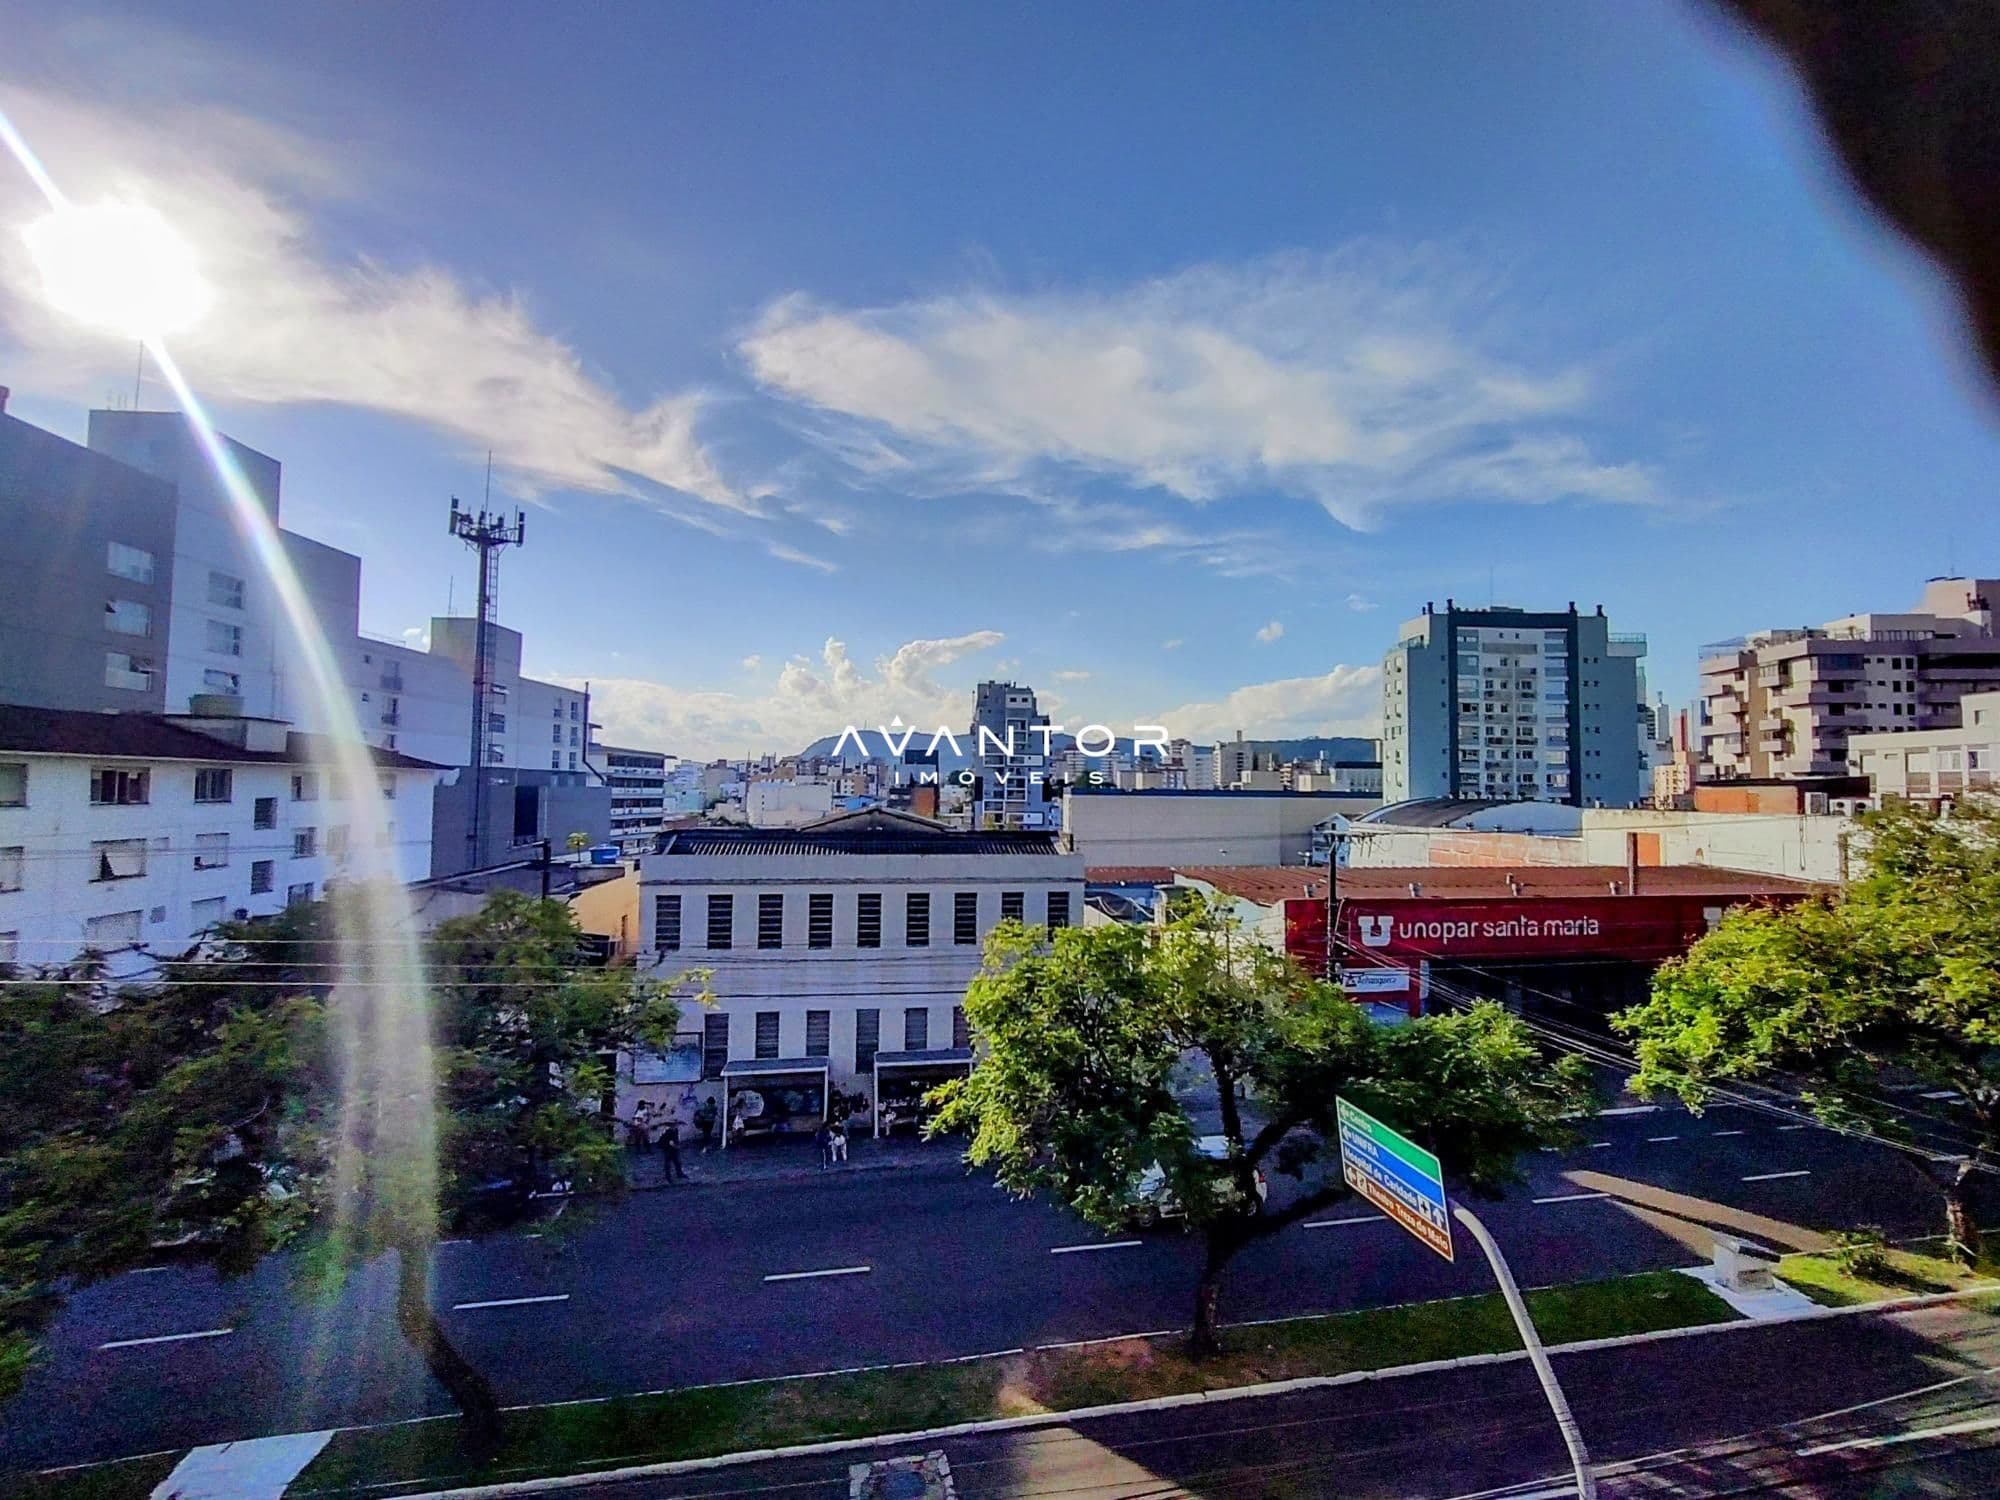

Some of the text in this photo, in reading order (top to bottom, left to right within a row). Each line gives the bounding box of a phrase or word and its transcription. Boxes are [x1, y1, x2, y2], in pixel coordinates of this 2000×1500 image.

[1399, 919, 1476, 945] unopar
[1482, 915, 1539, 937] santa
[1543, 915, 1600, 937] maria
[1344, 1146, 1373, 1174] Hospital
[1384, 1174, 1418, 1207] Caridade
[1427, 1225, 1449, 1250] Maio
